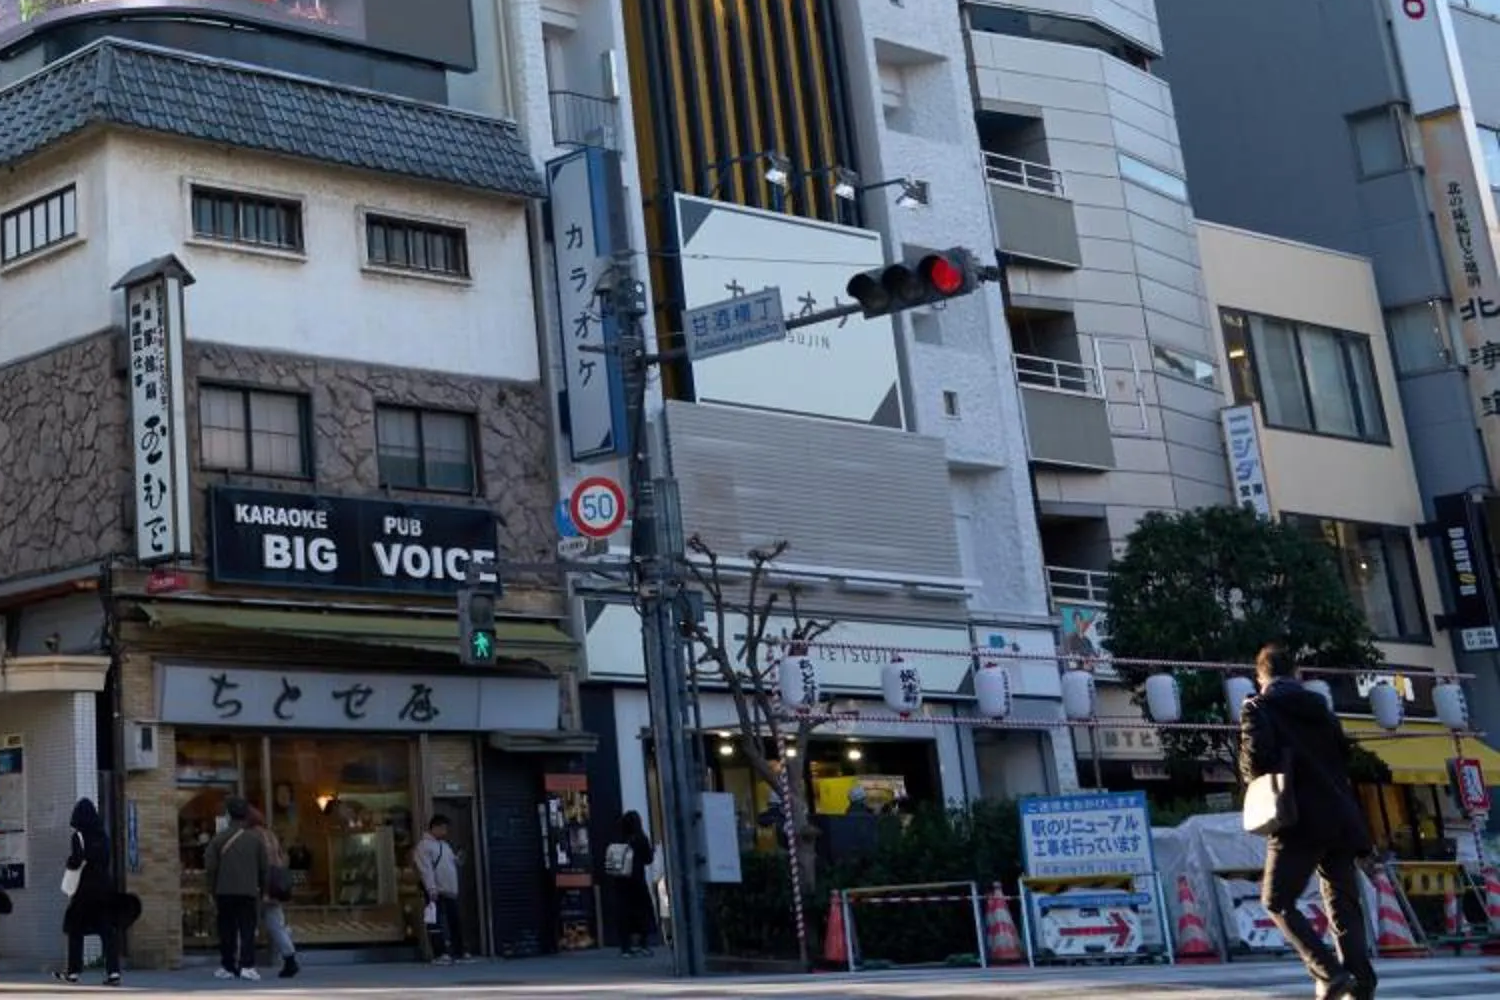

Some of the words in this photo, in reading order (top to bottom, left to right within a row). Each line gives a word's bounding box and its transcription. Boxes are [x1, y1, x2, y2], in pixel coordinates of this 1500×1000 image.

[565, 224, 596, 388] カラオケ
[235, 503, 328, 529] KARAOKE
[582, 493, 613, 521] 50
[383, 515, 423, 537] PUB
[262, 534, 338, 572] BIG
[372, 541, 498, 583] VOICE
[1031, 815, 1139, 837] 駅のリニューアル
[1033, 836, 1142, 857] 工事を行っています
